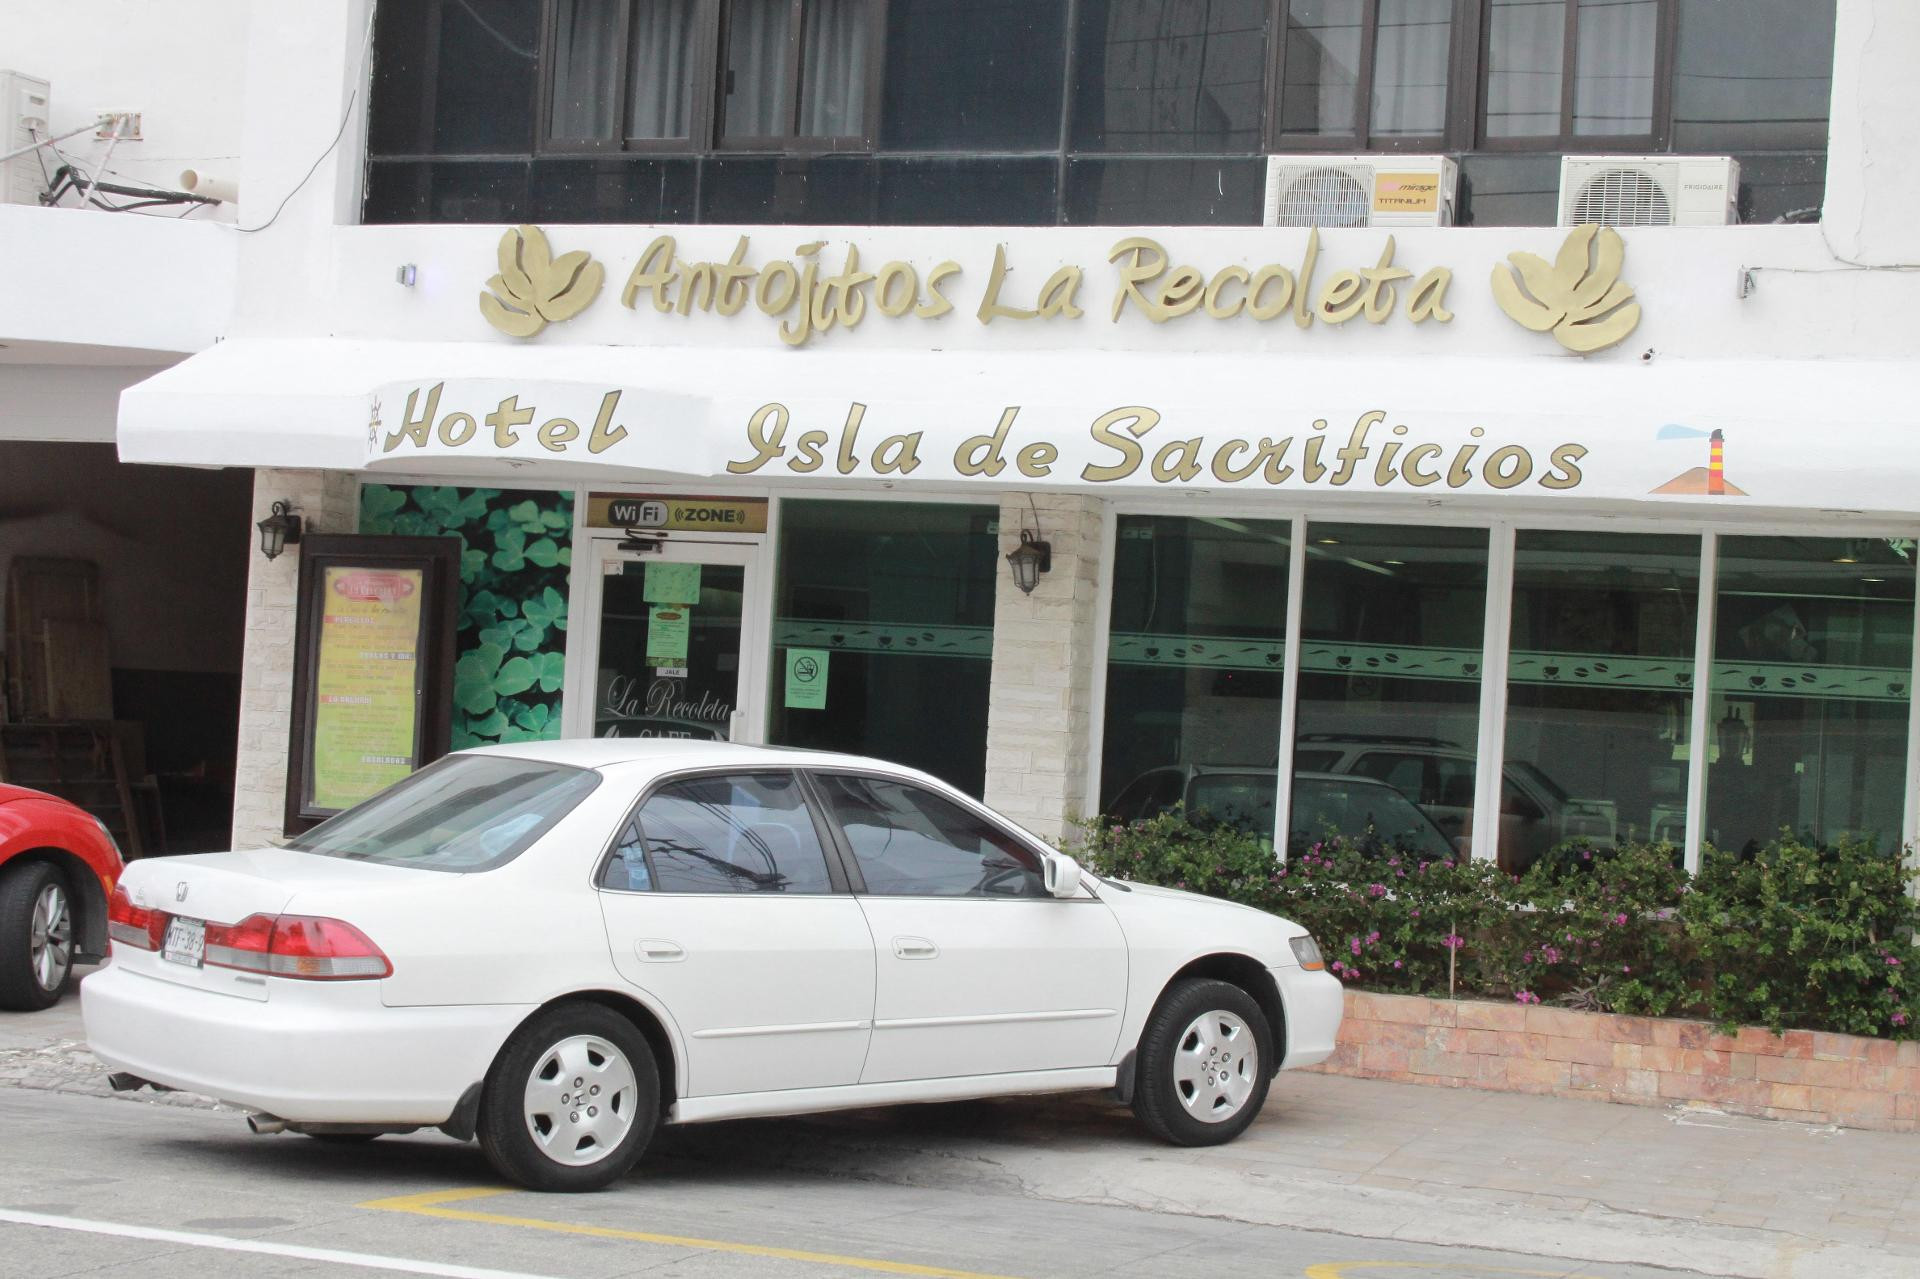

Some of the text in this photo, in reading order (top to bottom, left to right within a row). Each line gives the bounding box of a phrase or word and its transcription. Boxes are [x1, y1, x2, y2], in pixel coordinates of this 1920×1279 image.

[620, 224, 1455, 346] Antojitos La Recoleta
[383, 381, 1590, 490] Hotel Isla de Sacrificios
[684, 508, 736, 523] ZONE
[604, 675, 730, 721] La Recoleta
